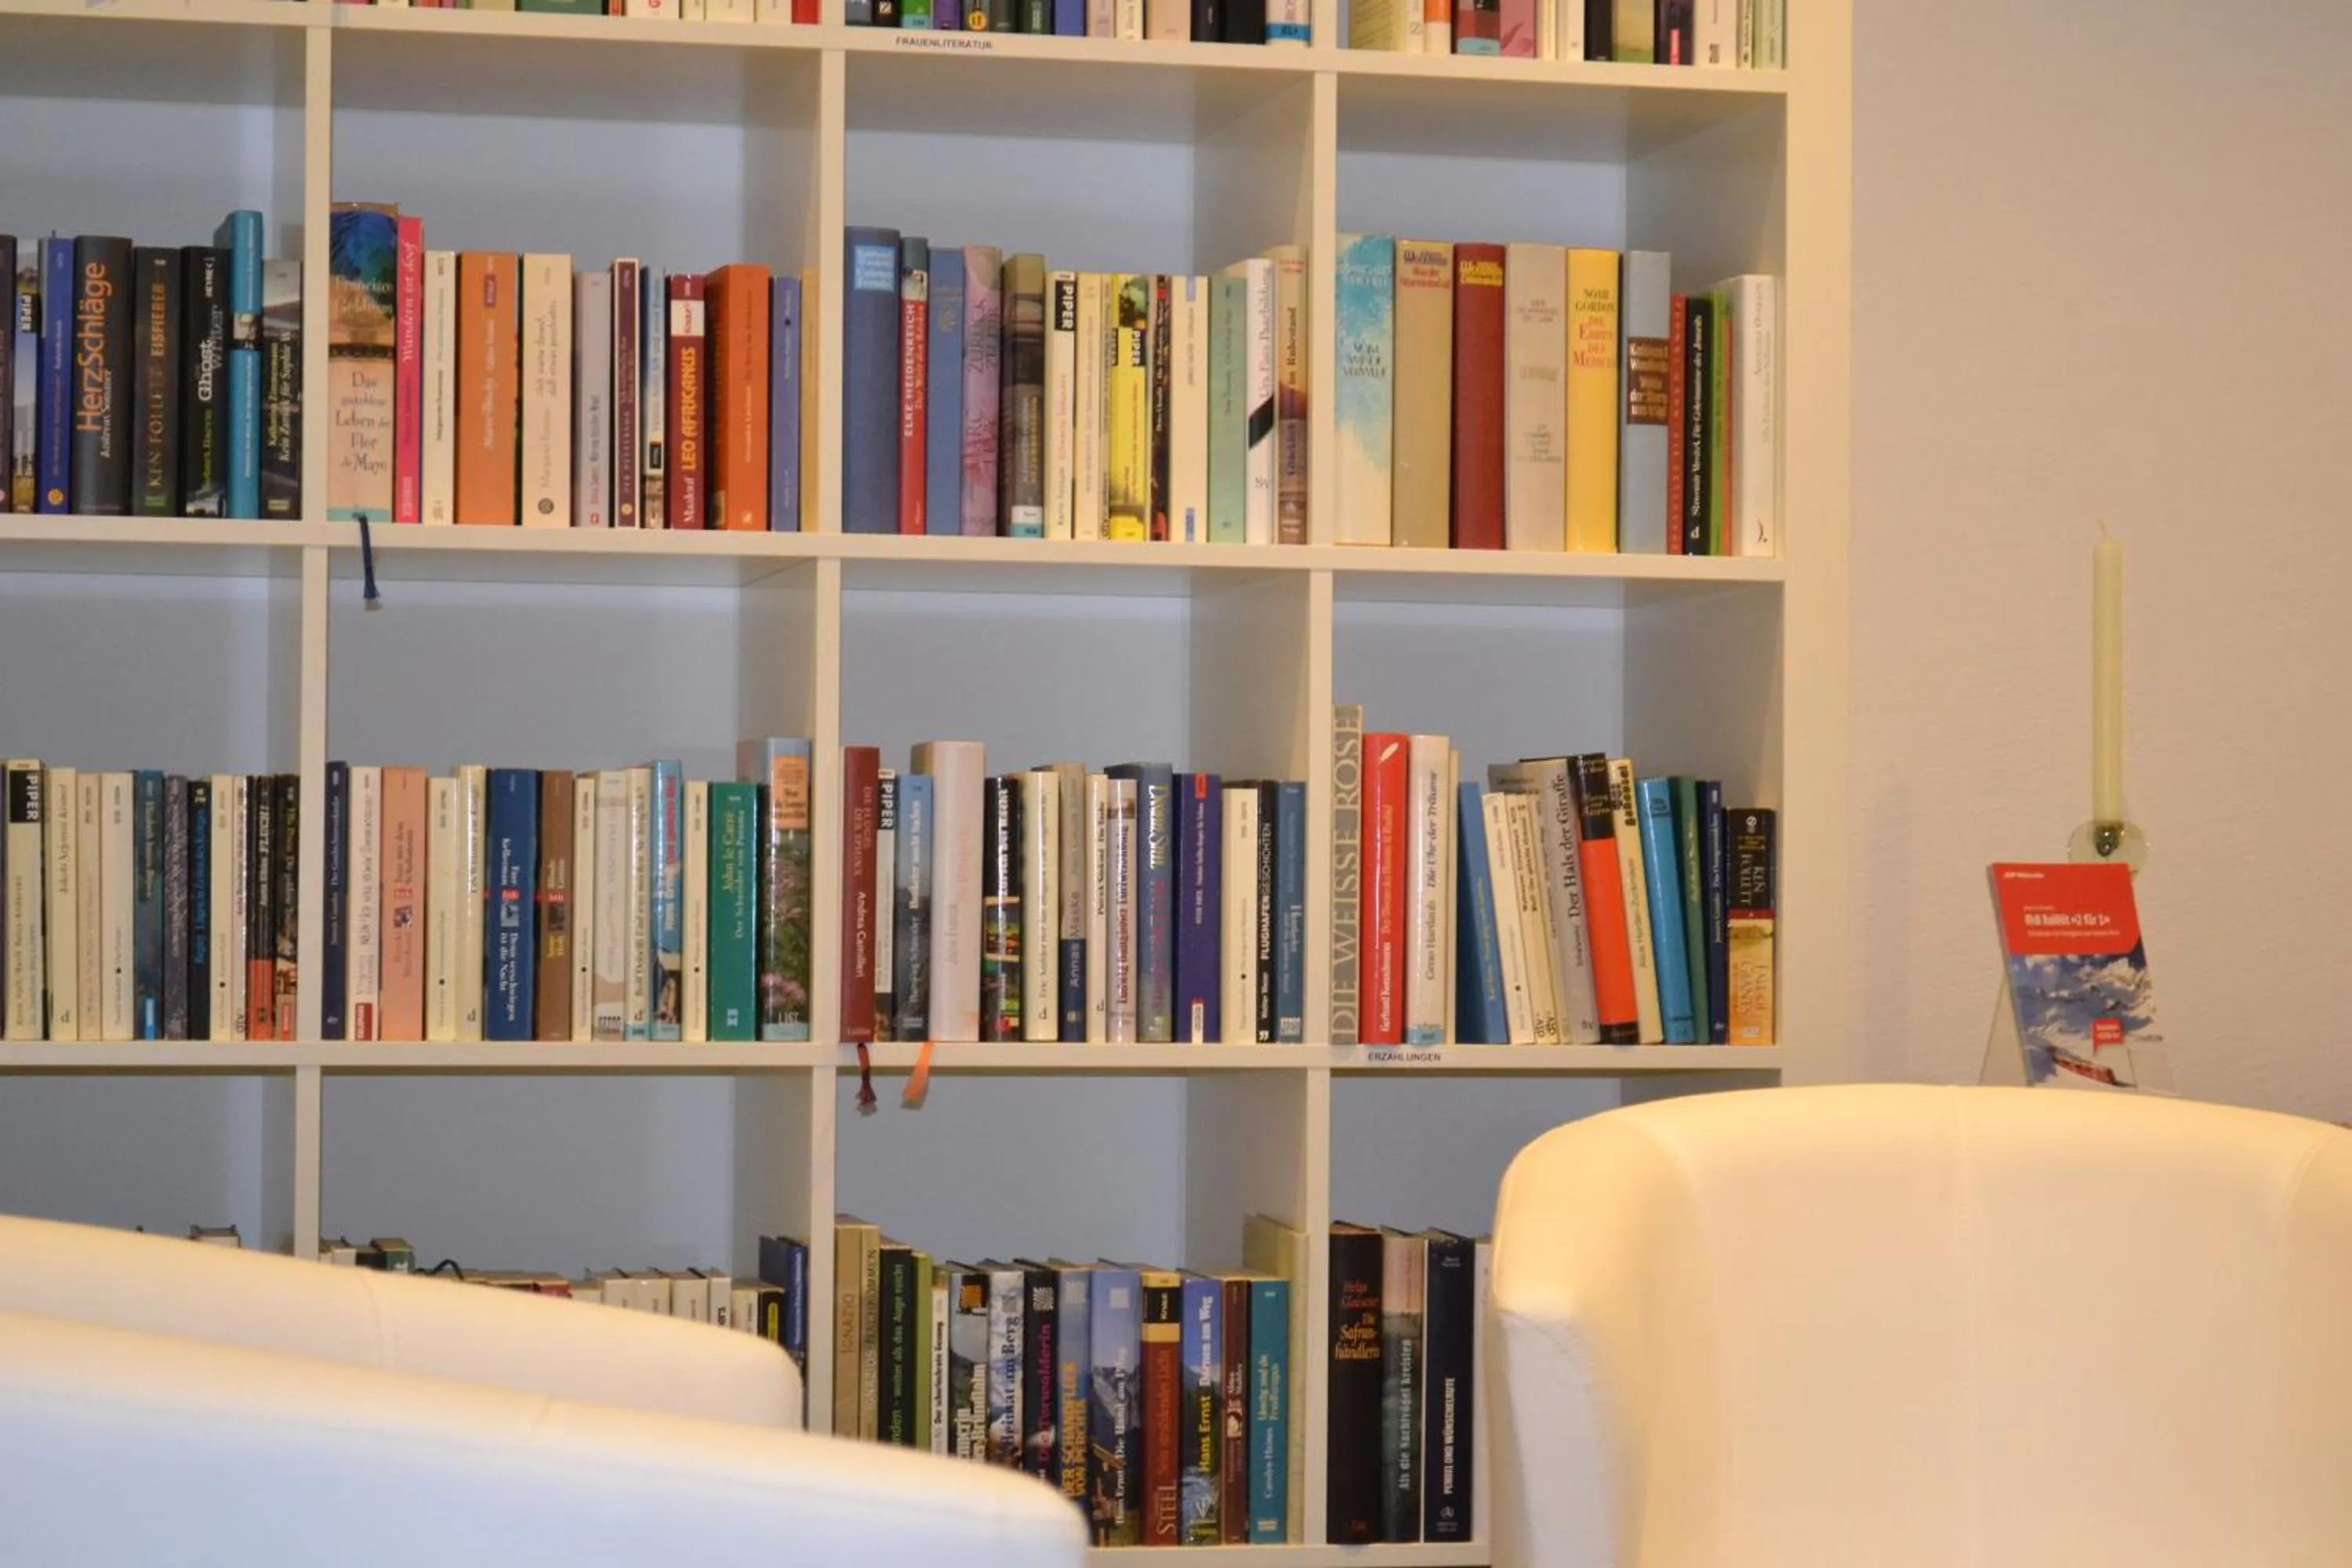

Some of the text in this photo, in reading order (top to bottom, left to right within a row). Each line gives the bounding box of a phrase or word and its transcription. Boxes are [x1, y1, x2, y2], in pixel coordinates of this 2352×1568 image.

[1062, 286, 1073, 328] PIPER
[77, 263, 112, 431] HerzSchläge
[1132, 330, 1141, 364] PIPER
[198, 339, 212, 401] Ghost
[681, 347, 696, 437] AFRICANUS
[905, 304, 914, 437] ELKE HEIDENREICH
[681, 441, 696, 470] LEO
[27, 773, 38, 818] PIPER
[882, 781, 892, 827] PIPER
[1555, 774, 1572, 825] Giraffe
[1559, 829, 1573, 850] der
[1333, 717, 1359, 1035] DIE WEISSE ROSE
[1563, 854, 1577, 887] Hals
[1566, 892, 1581, 917] Der
[840, 1293, 855, 1353] IGNAZIO
[1001, 1316, 1018, 1353] Berg
[1199, 1396, 1213, 1432] Ernst
[1199, 1436, 1213, 1472] Hans
[1156, 1480, 1177, 1534] STEEL
